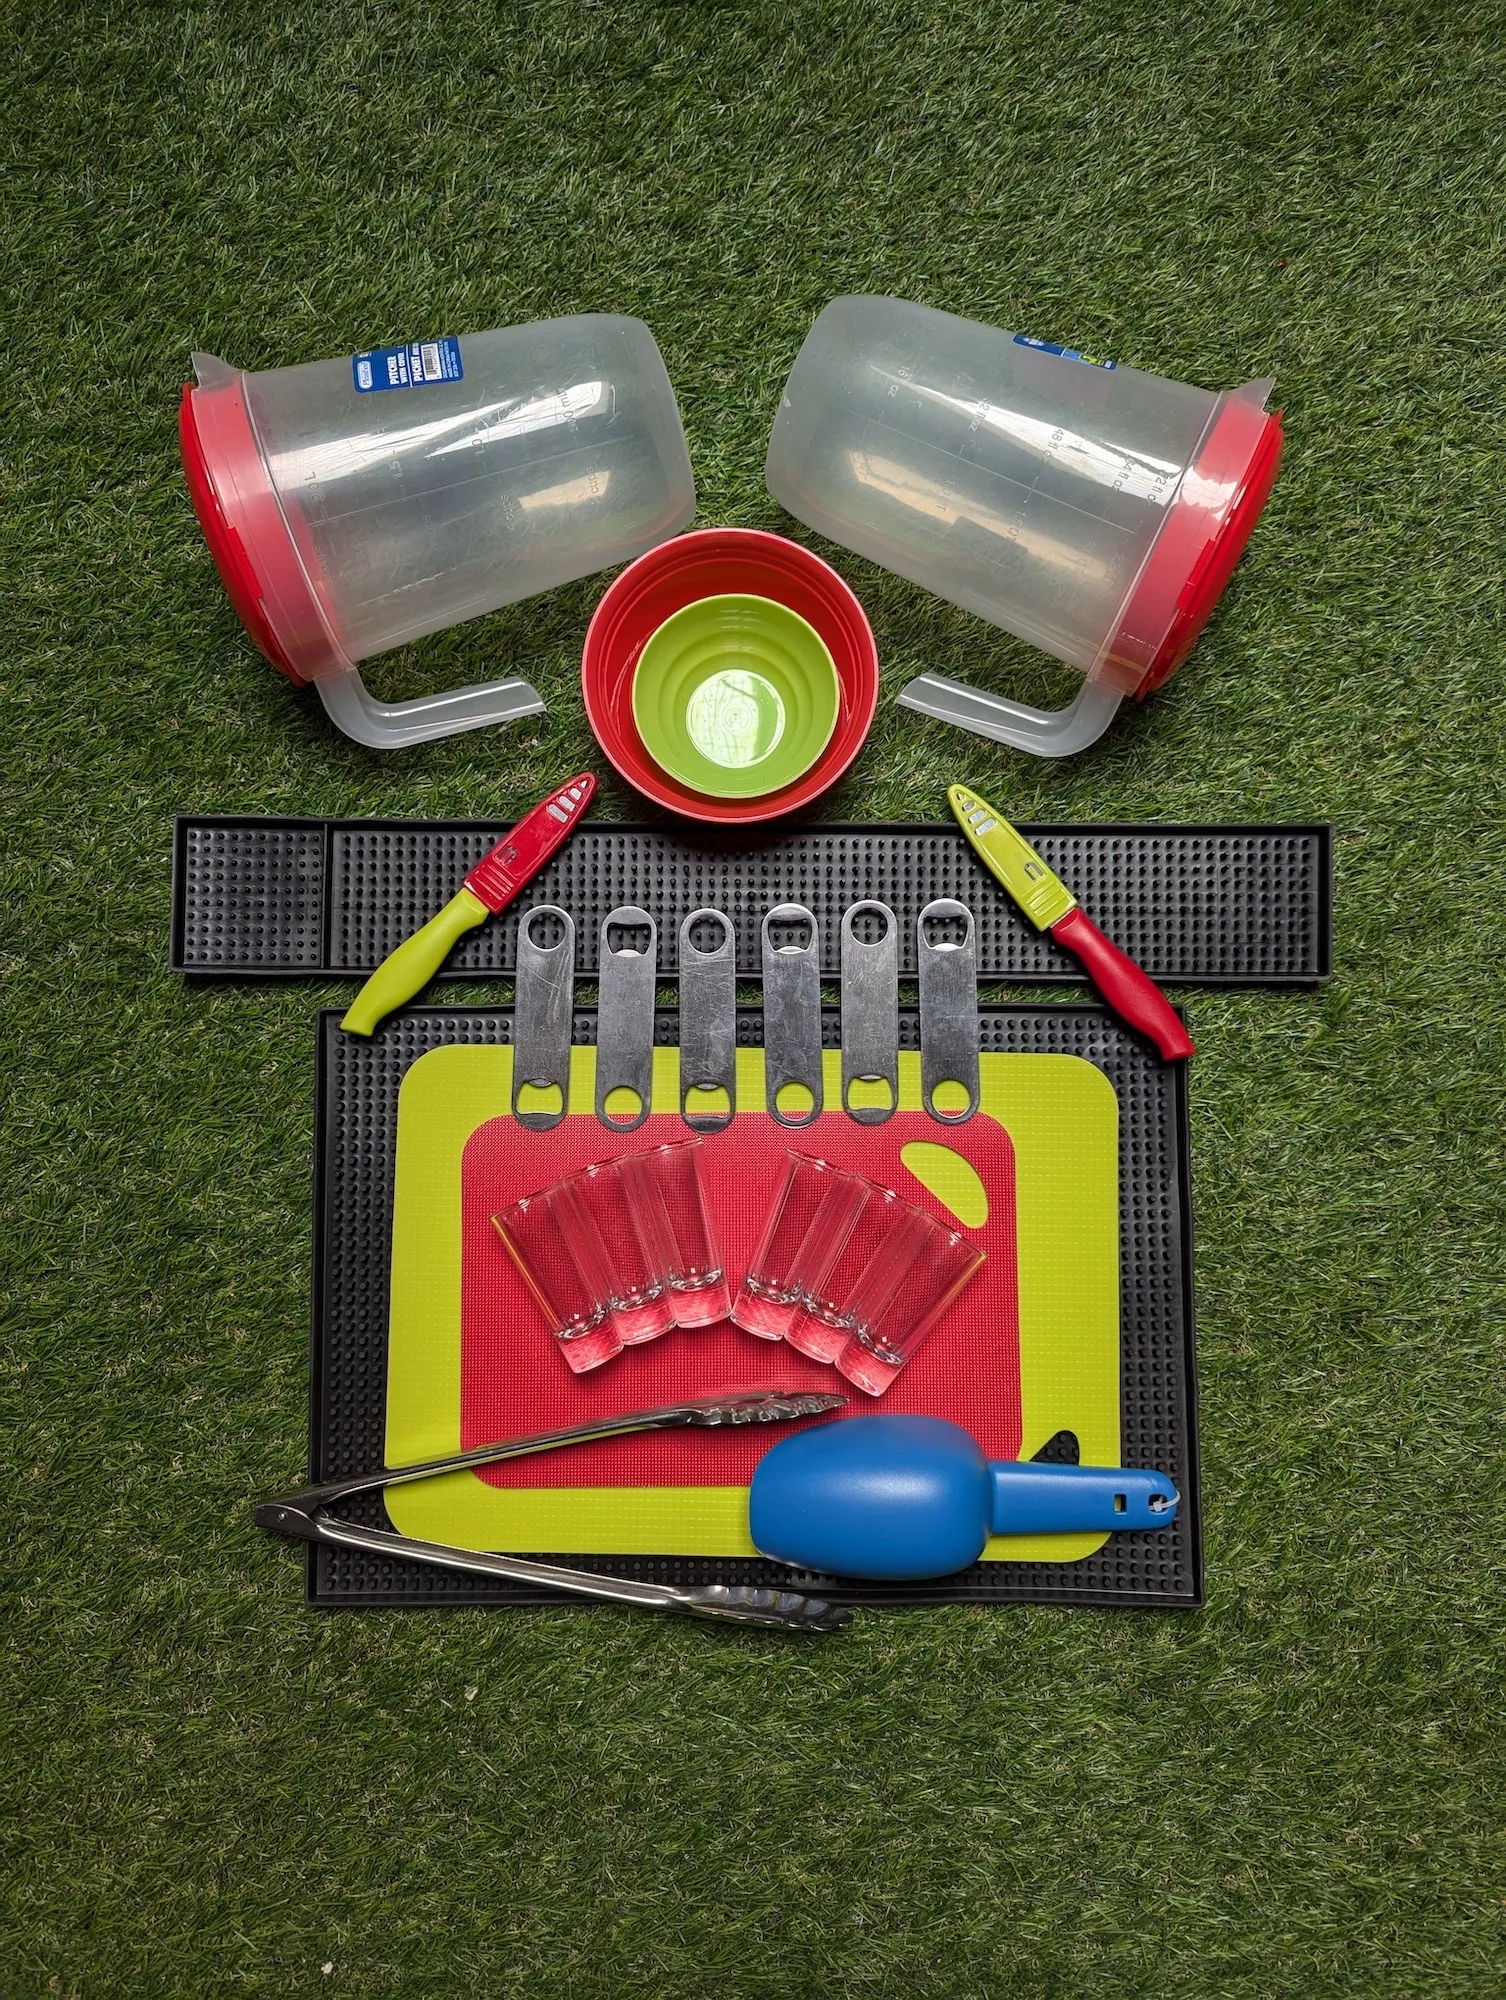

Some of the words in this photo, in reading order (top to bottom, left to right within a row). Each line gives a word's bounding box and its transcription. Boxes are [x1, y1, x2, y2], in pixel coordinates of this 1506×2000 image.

[387, 355, 400, 385] PITCHER
[399, 367, 408, 384] WITH
[410, 356, 423, 382] PICHET
[898, 365, 910, 378] 16
[1051, 428, 1064, 442] 48
[1047, 441, 1059, 450] fl
[304, 471, 316, 481] L
[585, 466, 600, 494] cups
[1118, 471, 1129, 480] fl
[308, 482, 325, 503] 2.0
[1151, 485, 1163, 494] fl
[500, 494, 515, 521] cups
